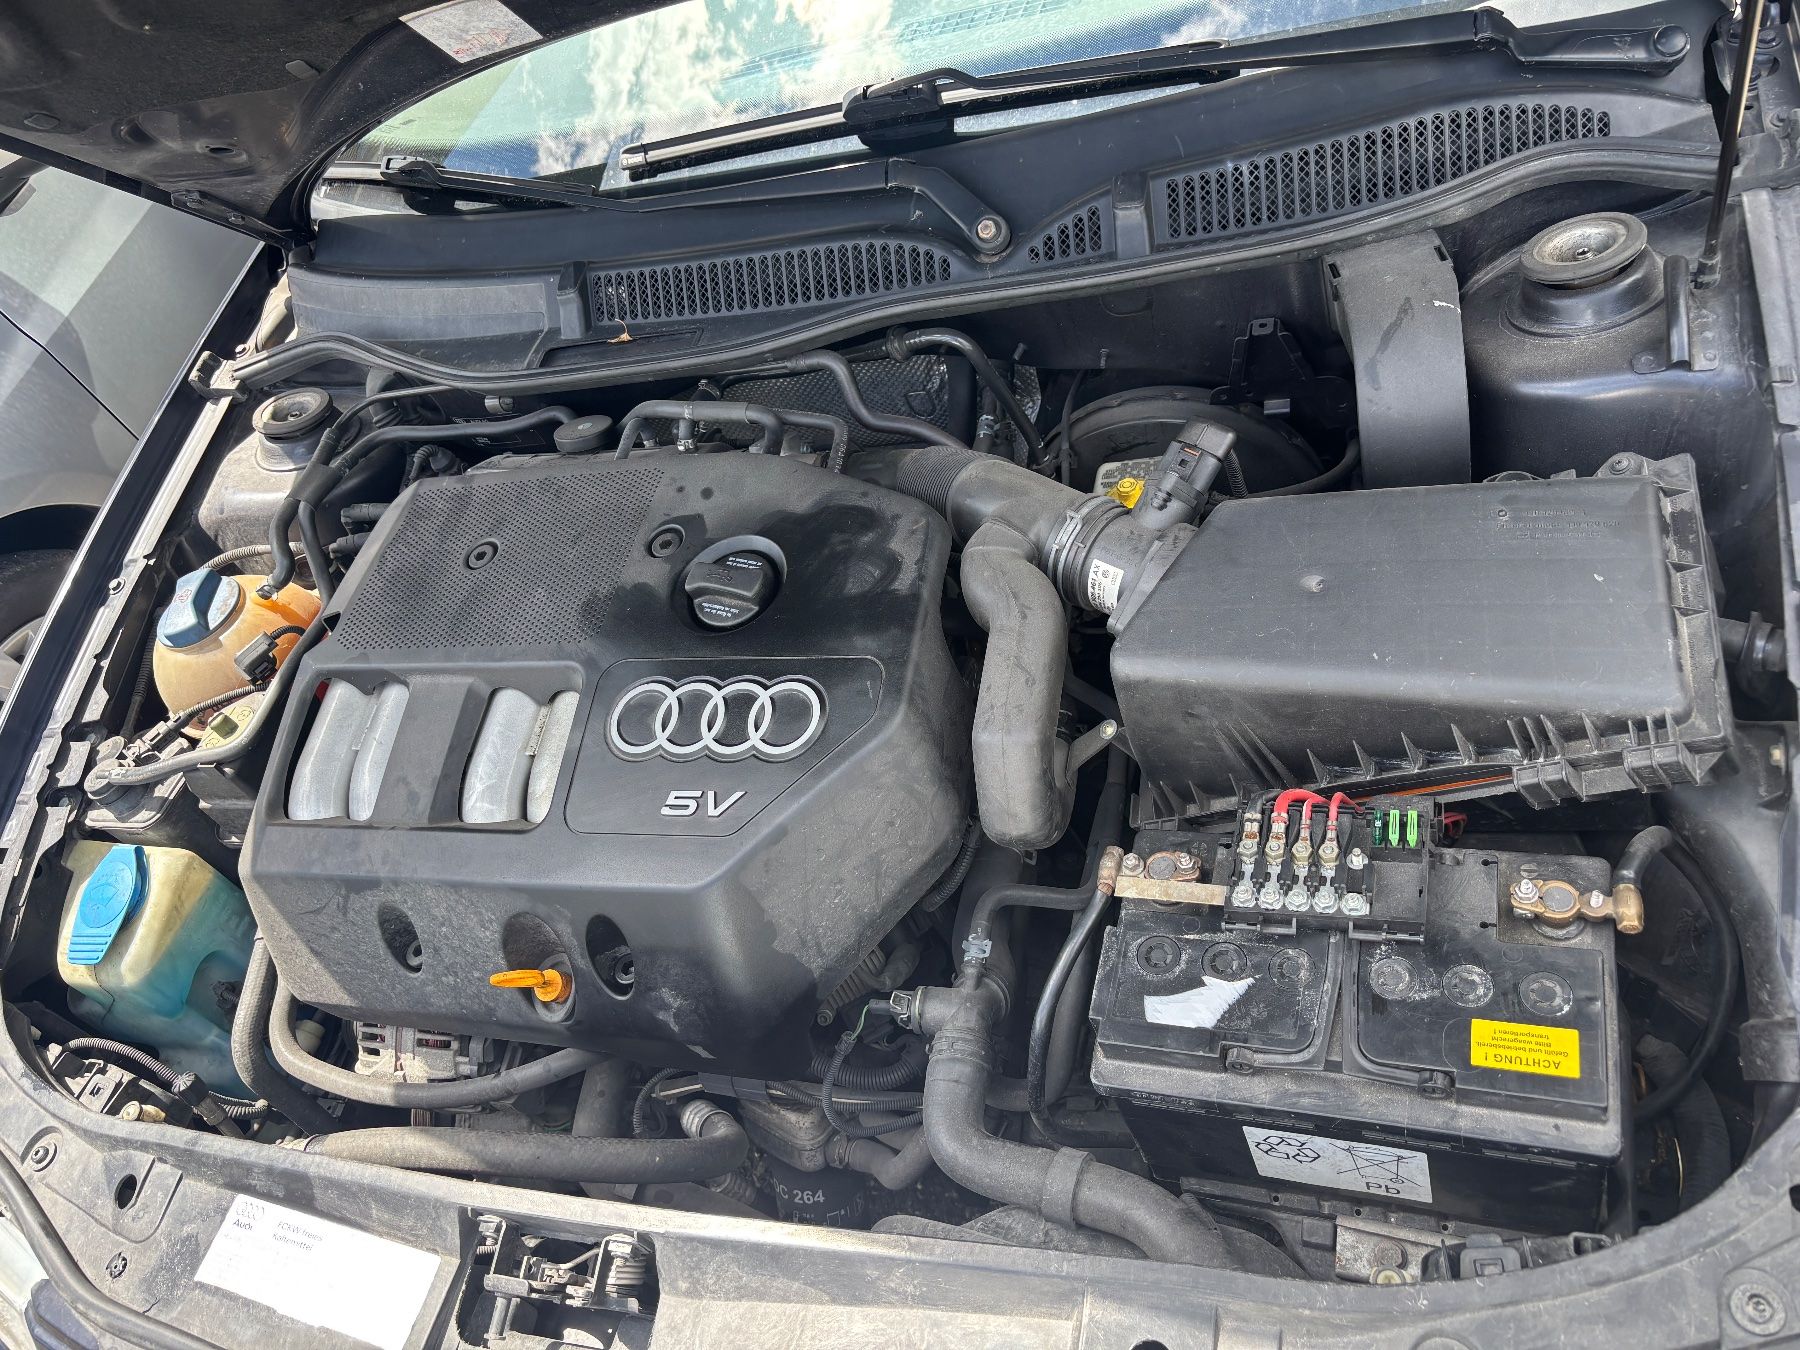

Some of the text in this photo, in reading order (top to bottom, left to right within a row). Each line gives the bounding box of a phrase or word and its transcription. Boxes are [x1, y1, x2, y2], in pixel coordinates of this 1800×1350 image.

[661, 790, 747, 817] 5V
[1493, 1053, 1561, 1069] ACHTUNG
[1366, 1181, 1400, 1195] Pb
[793, 1189, 825, 1204] 264
[232, 1218, 253, 1232] Audi
